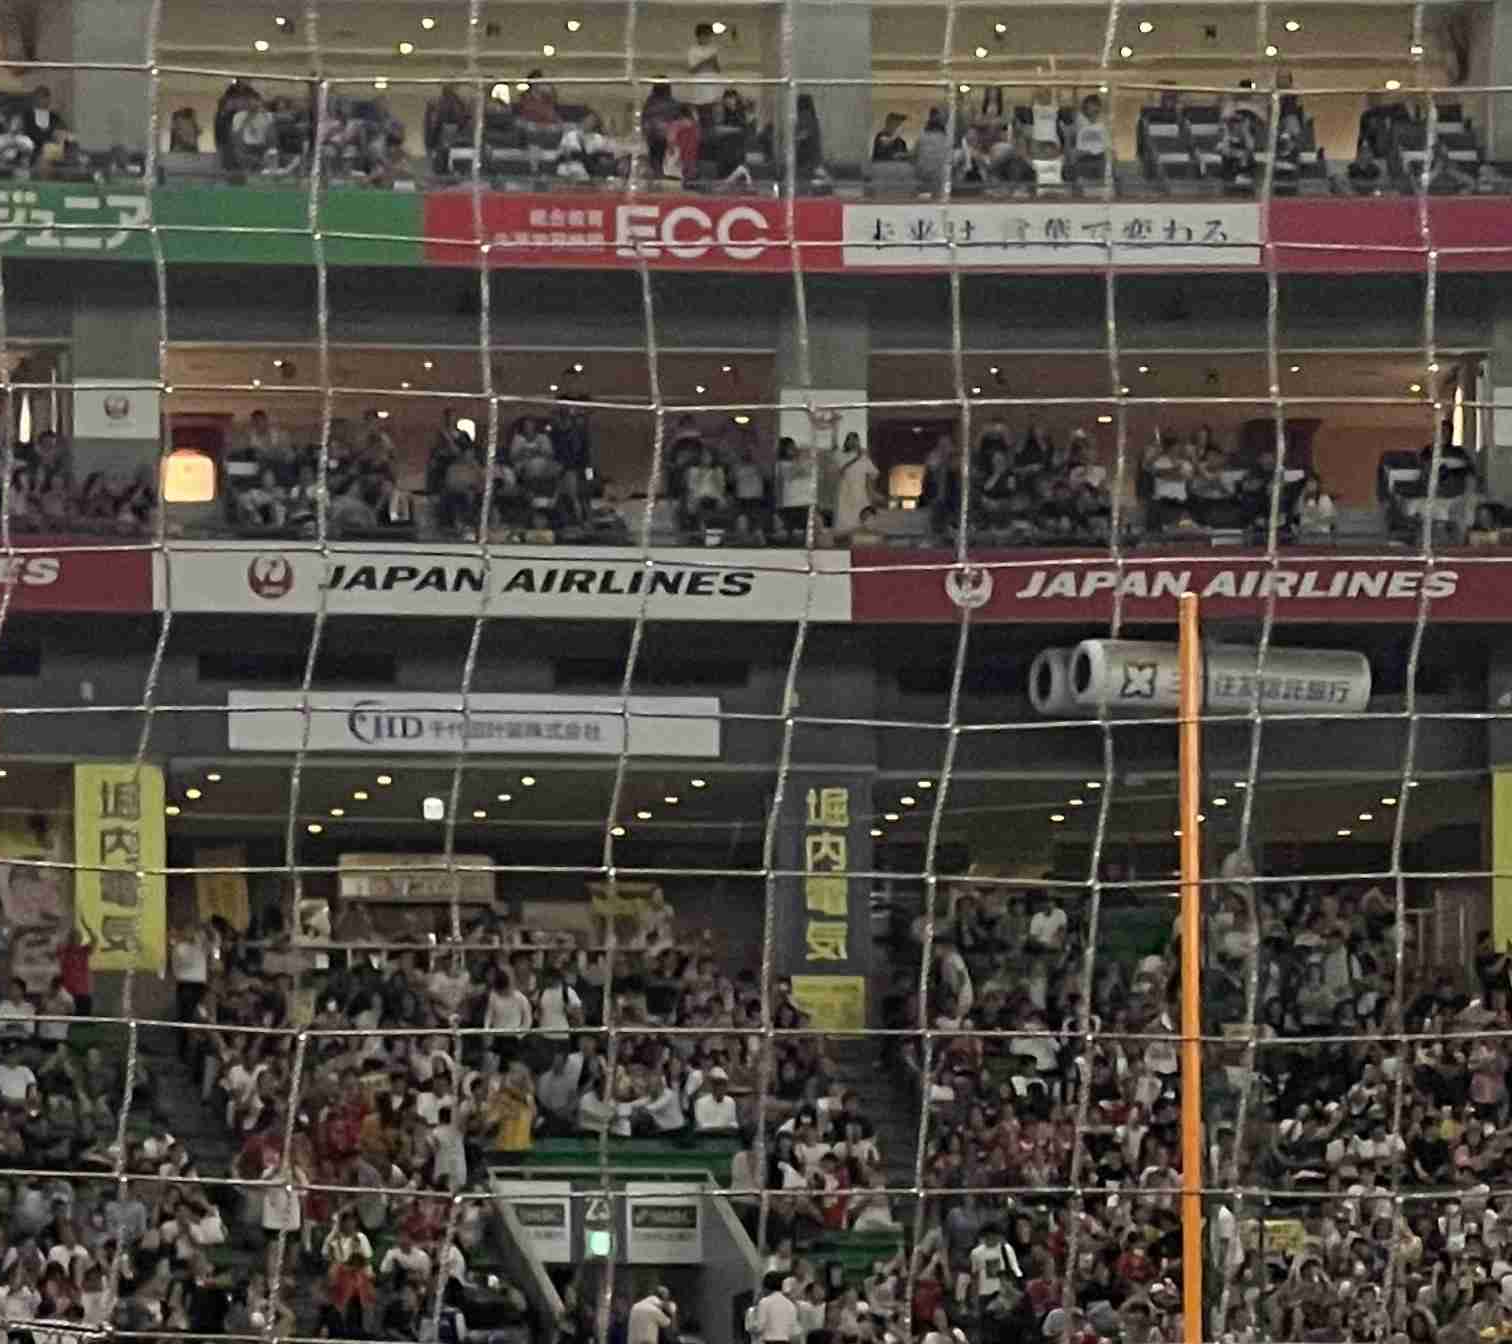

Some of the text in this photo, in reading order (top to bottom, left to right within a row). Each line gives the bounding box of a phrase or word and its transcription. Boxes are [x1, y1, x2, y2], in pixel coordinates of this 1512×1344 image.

[615, 205, 769, 259] ECC
[320, 564, 756, 597] JAPAN AIRLINES
[1016, 570, 1459, 599] JAPAN AIRLINES
